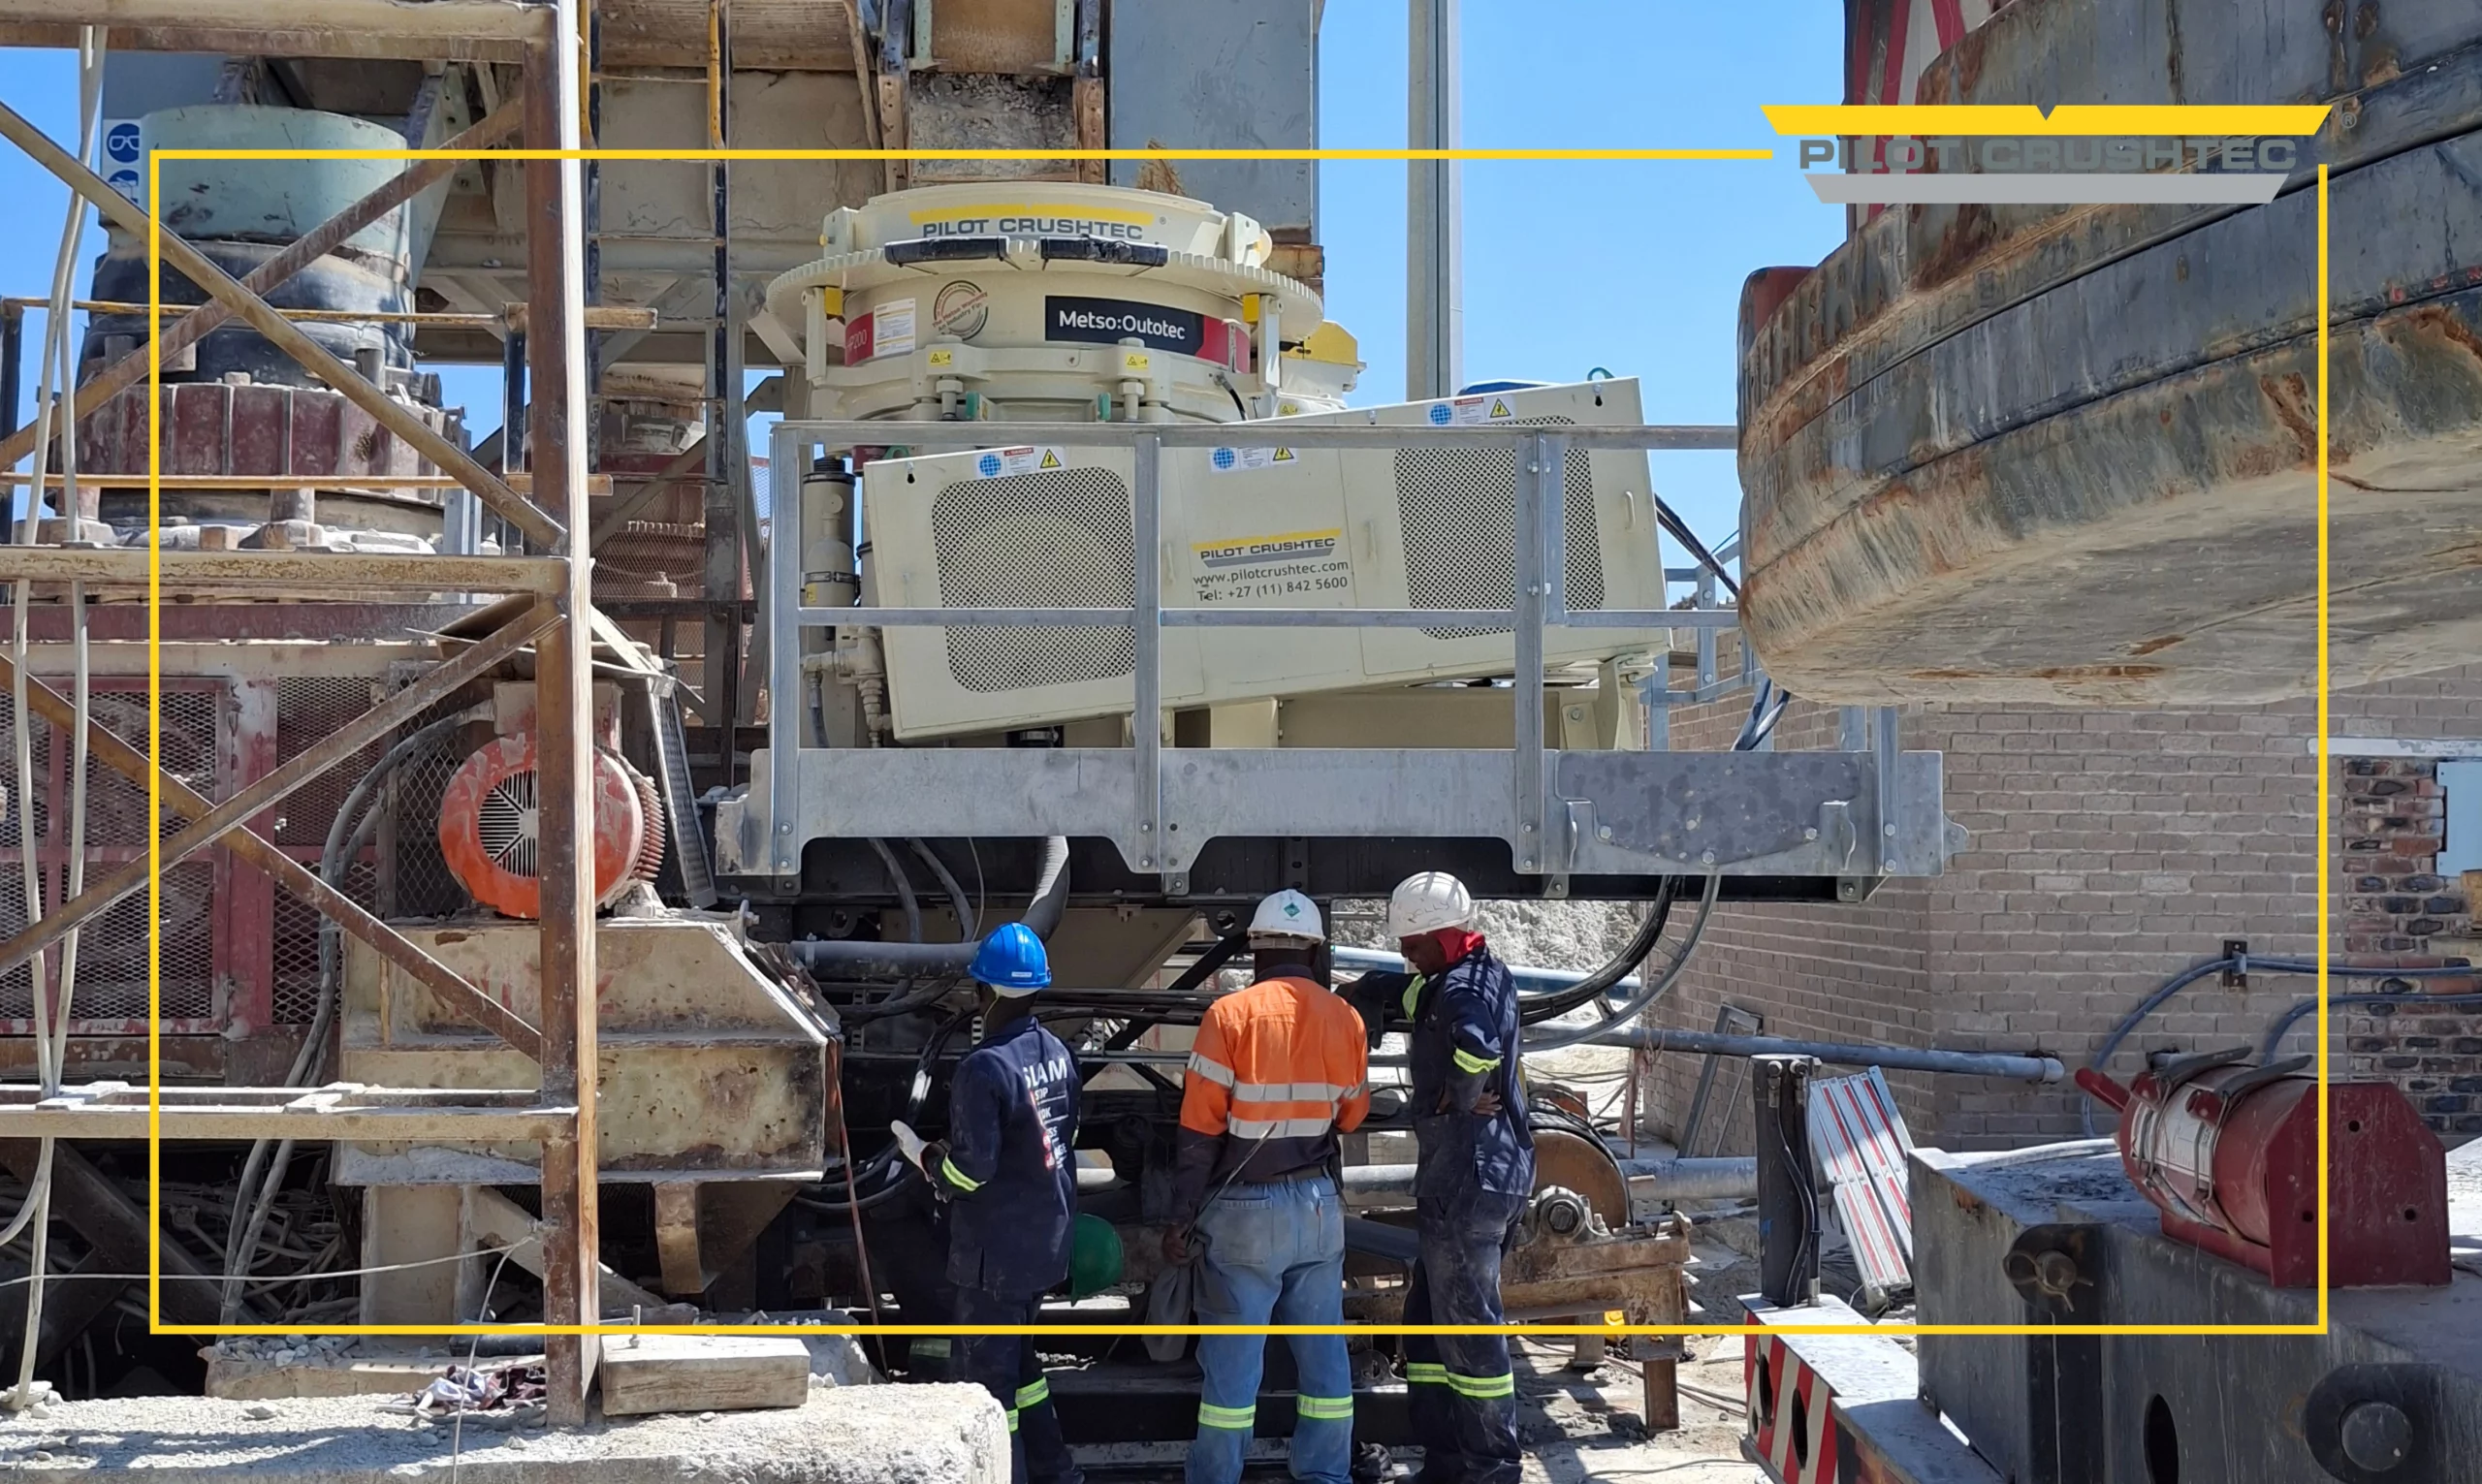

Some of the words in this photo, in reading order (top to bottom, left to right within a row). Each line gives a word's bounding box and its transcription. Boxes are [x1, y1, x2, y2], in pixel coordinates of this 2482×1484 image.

[923, 219, 989, 238] PILOT
[999, 218, 1143, 240] CRUSHTEC
[1059, 309, 1186, 340] Metso:Outotec
[1200, 547, 1245, 560] PILOT
[1250, 537, 1336, 554] CRUSHTEC
[1193, 560, 1350, 584] www.pilotcrushtec.com
[1196, 588, 1223, 602] Tel:
[1227, 585, 1252, 599] +27
[1257, 583, 1283, 597] (11)
[1287, 581, 1312, 593] 842
[1315, 576, 1349, 590] 5600
